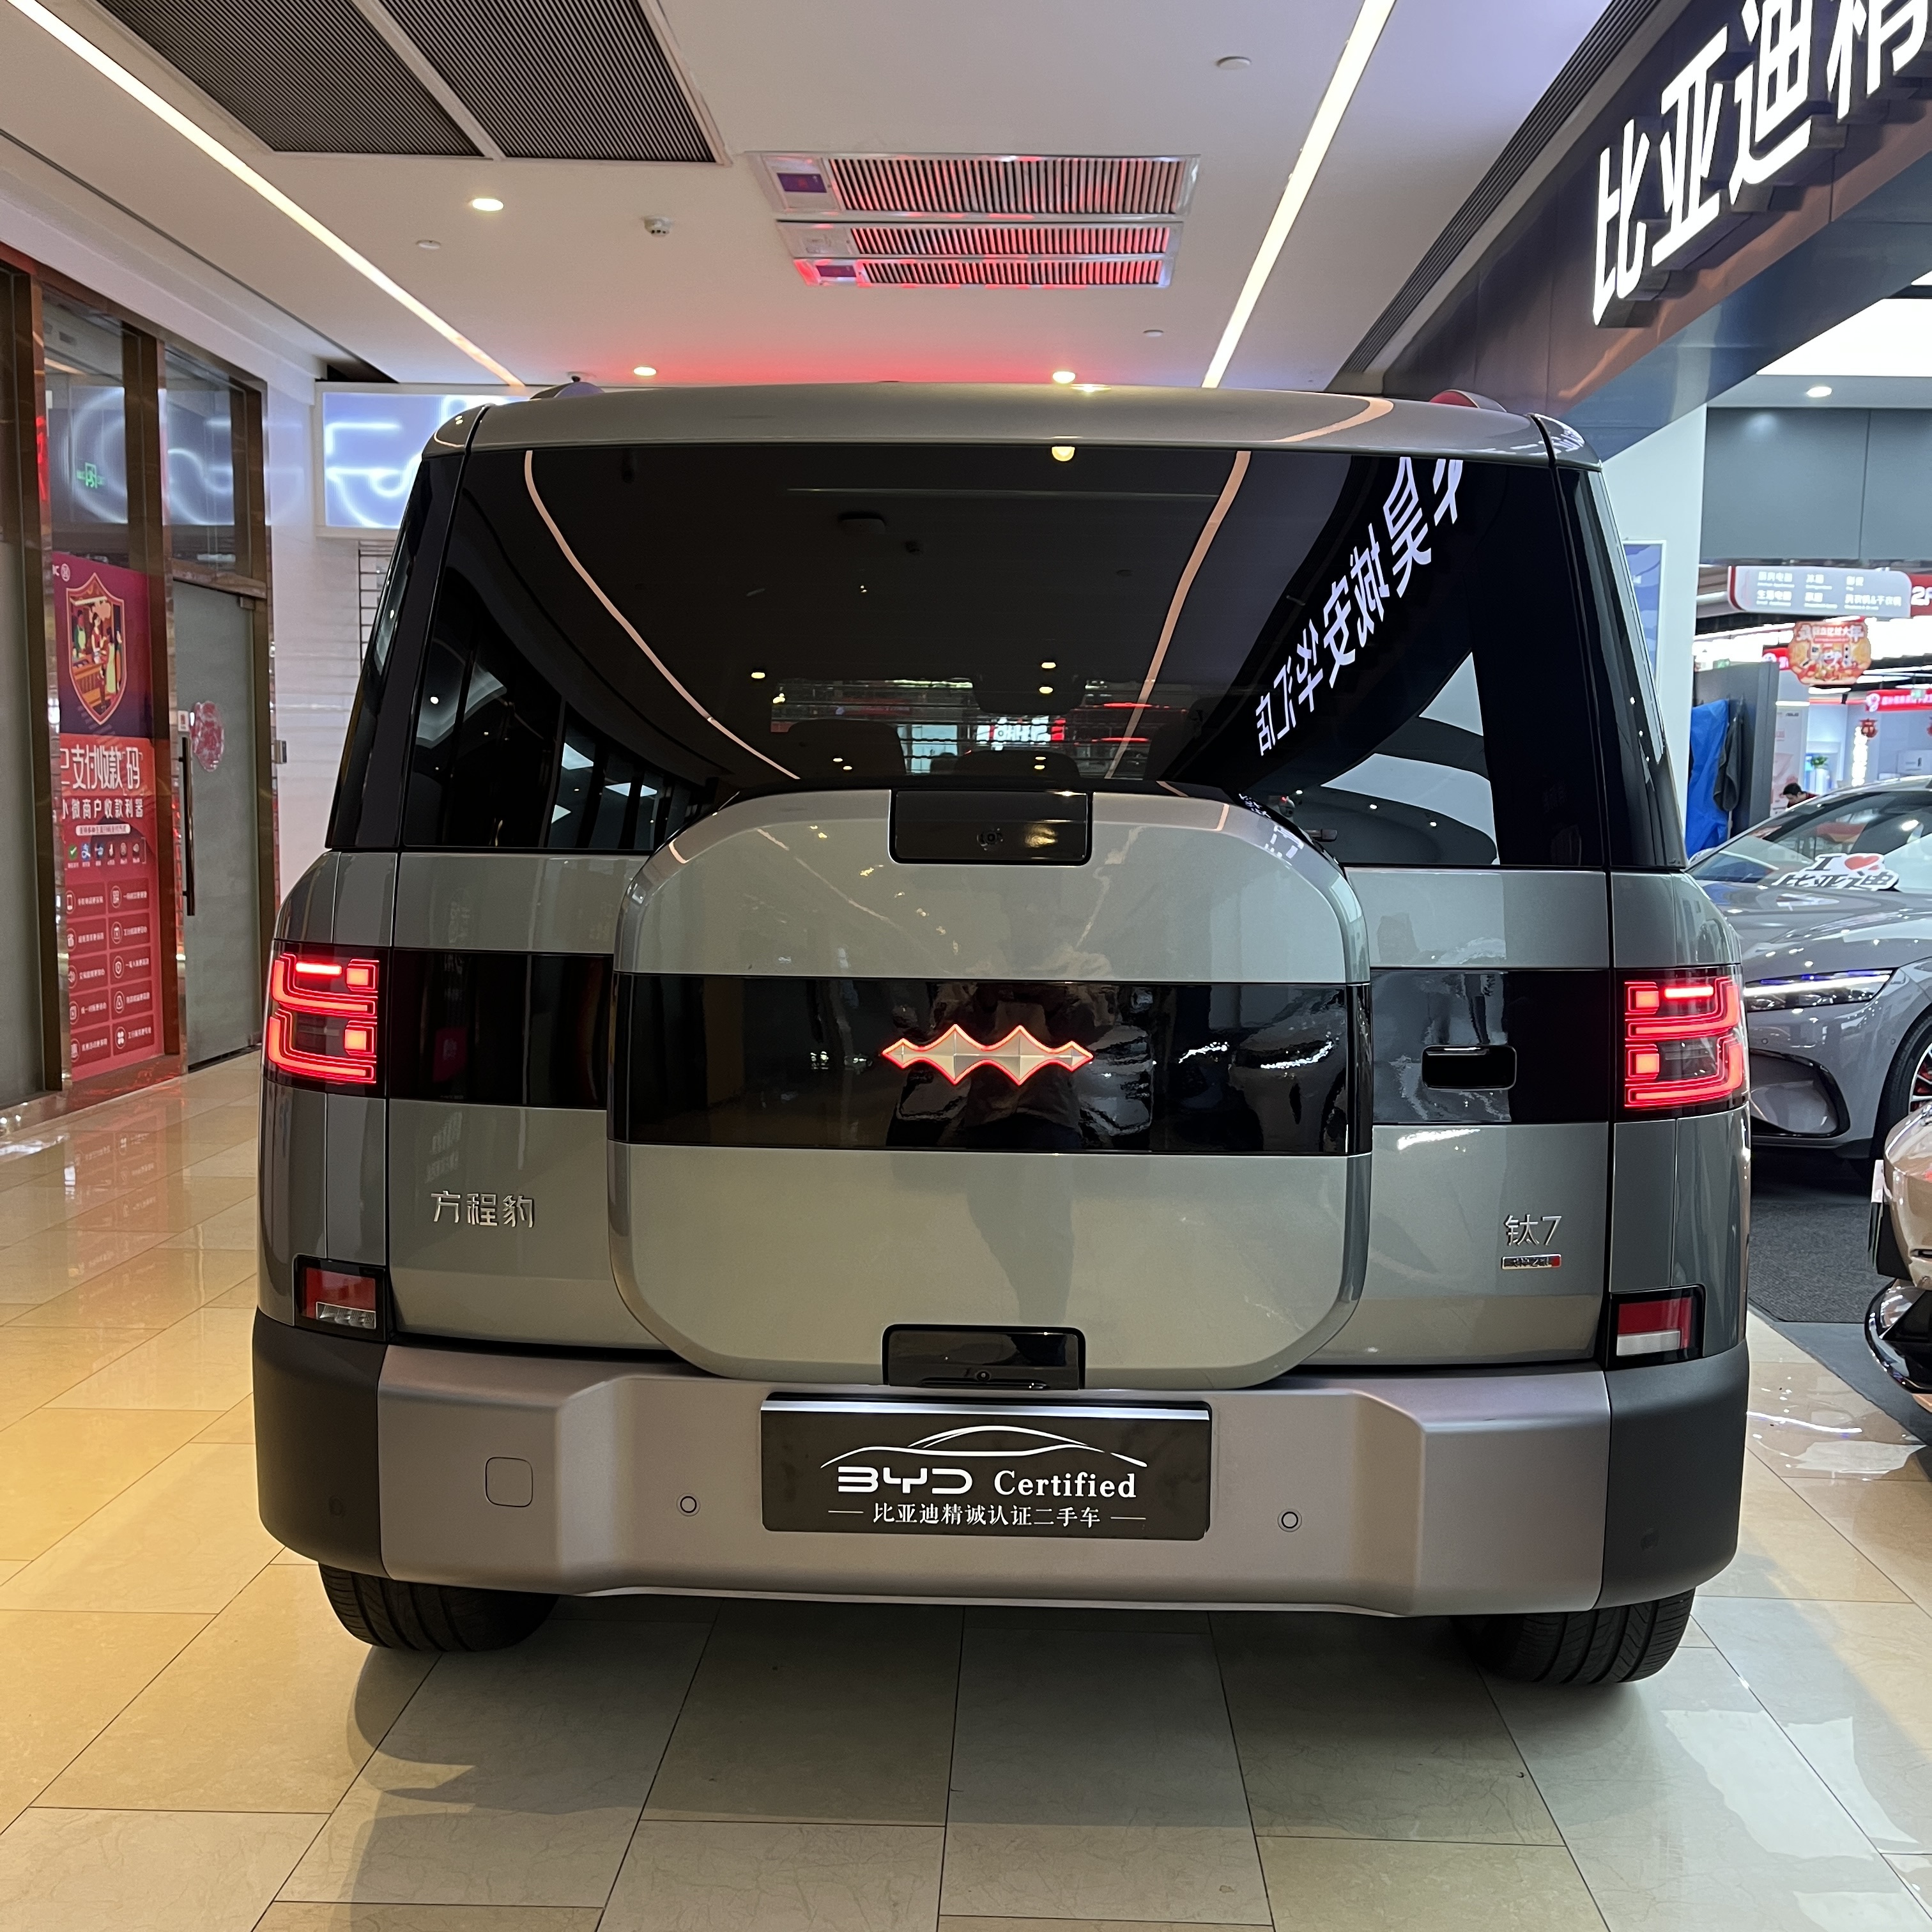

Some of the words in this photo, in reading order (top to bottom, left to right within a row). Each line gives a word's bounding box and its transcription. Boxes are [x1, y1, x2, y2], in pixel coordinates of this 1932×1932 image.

[1781, 870, 1894, 891] 比亚迪
[431, 1190, 533, 1228] 方程豹
[1505, 1214, 1562, 1246] 钛7
[838, 1466, 973, 1494] BYD
[994, 1470, 1137, 1498] Certified
[873, 1503, 1101, 1528] 比亚迪精诚认证二手车
